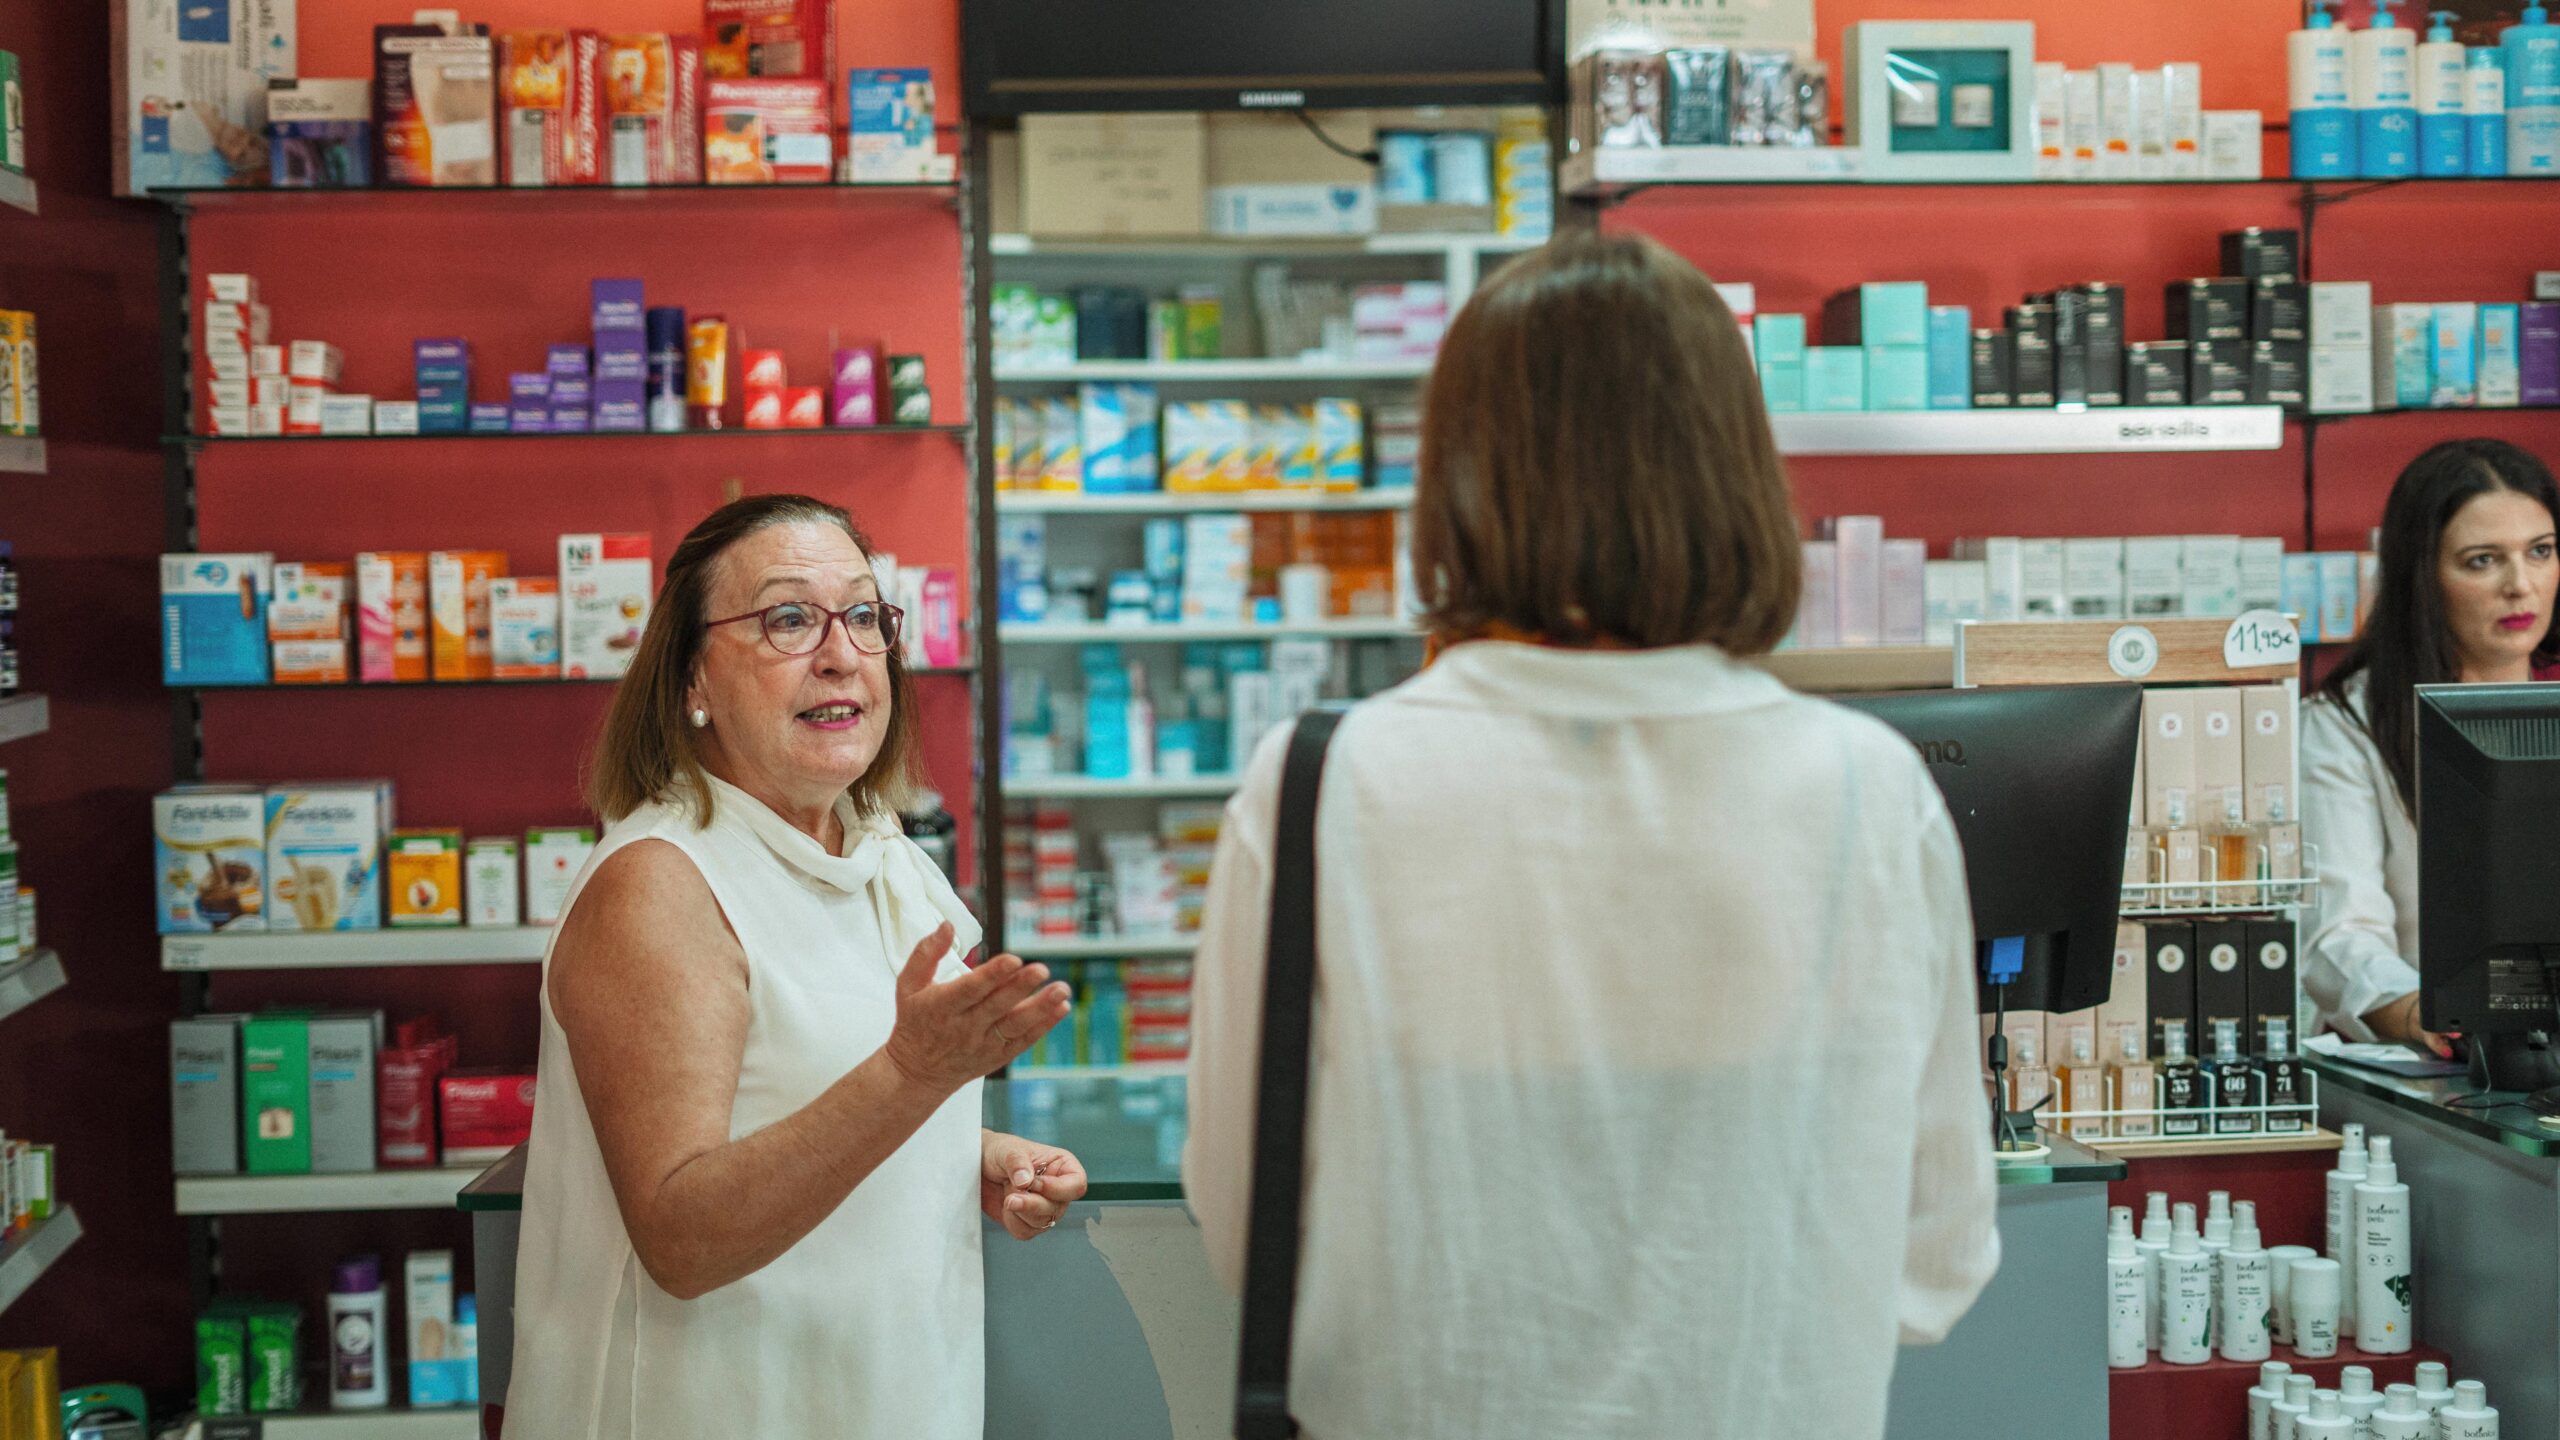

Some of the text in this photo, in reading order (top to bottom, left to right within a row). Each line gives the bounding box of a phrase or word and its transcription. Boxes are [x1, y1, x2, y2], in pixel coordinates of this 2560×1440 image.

[1239, 91, 1304, 106] SAMSUNG
[2232, 622, 2293, 653] 11,95€
[2276, 1076, 2292, 1092] 71
